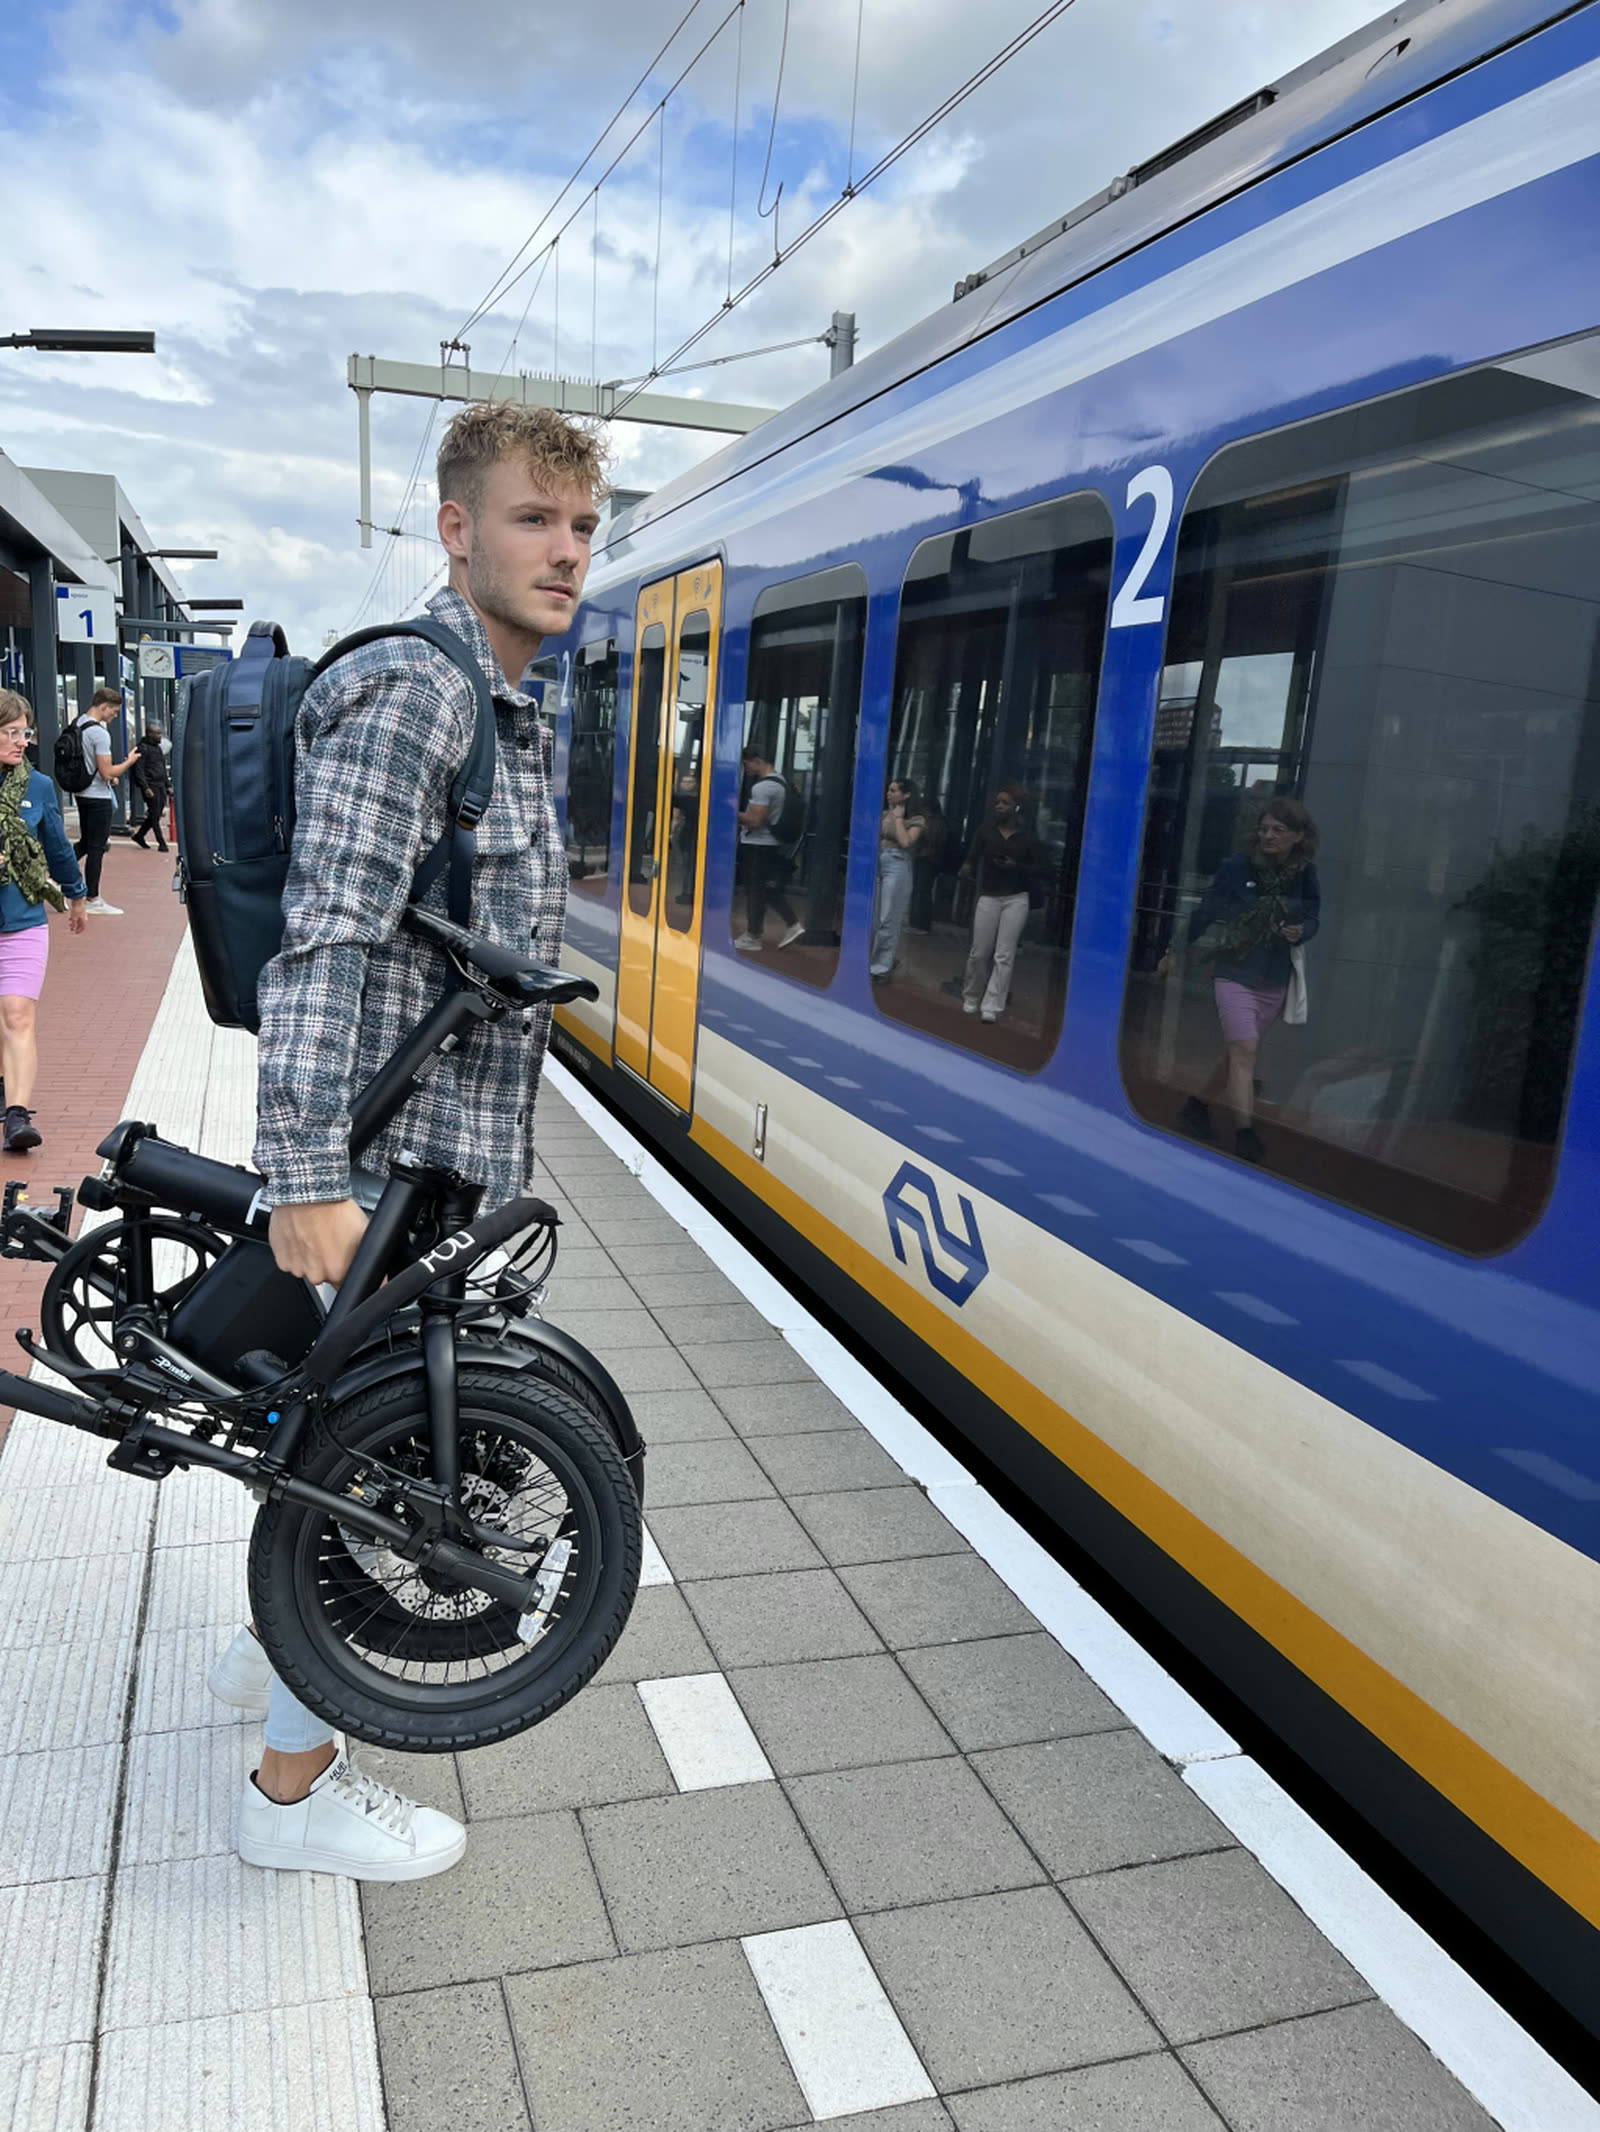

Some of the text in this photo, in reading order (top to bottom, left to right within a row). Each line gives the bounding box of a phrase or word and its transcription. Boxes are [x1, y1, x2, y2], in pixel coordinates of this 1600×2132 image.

[1110, 465, 1174, 629] 2
[78, 609, 93, 637] 1
[560, 650, 570, 707] 2
